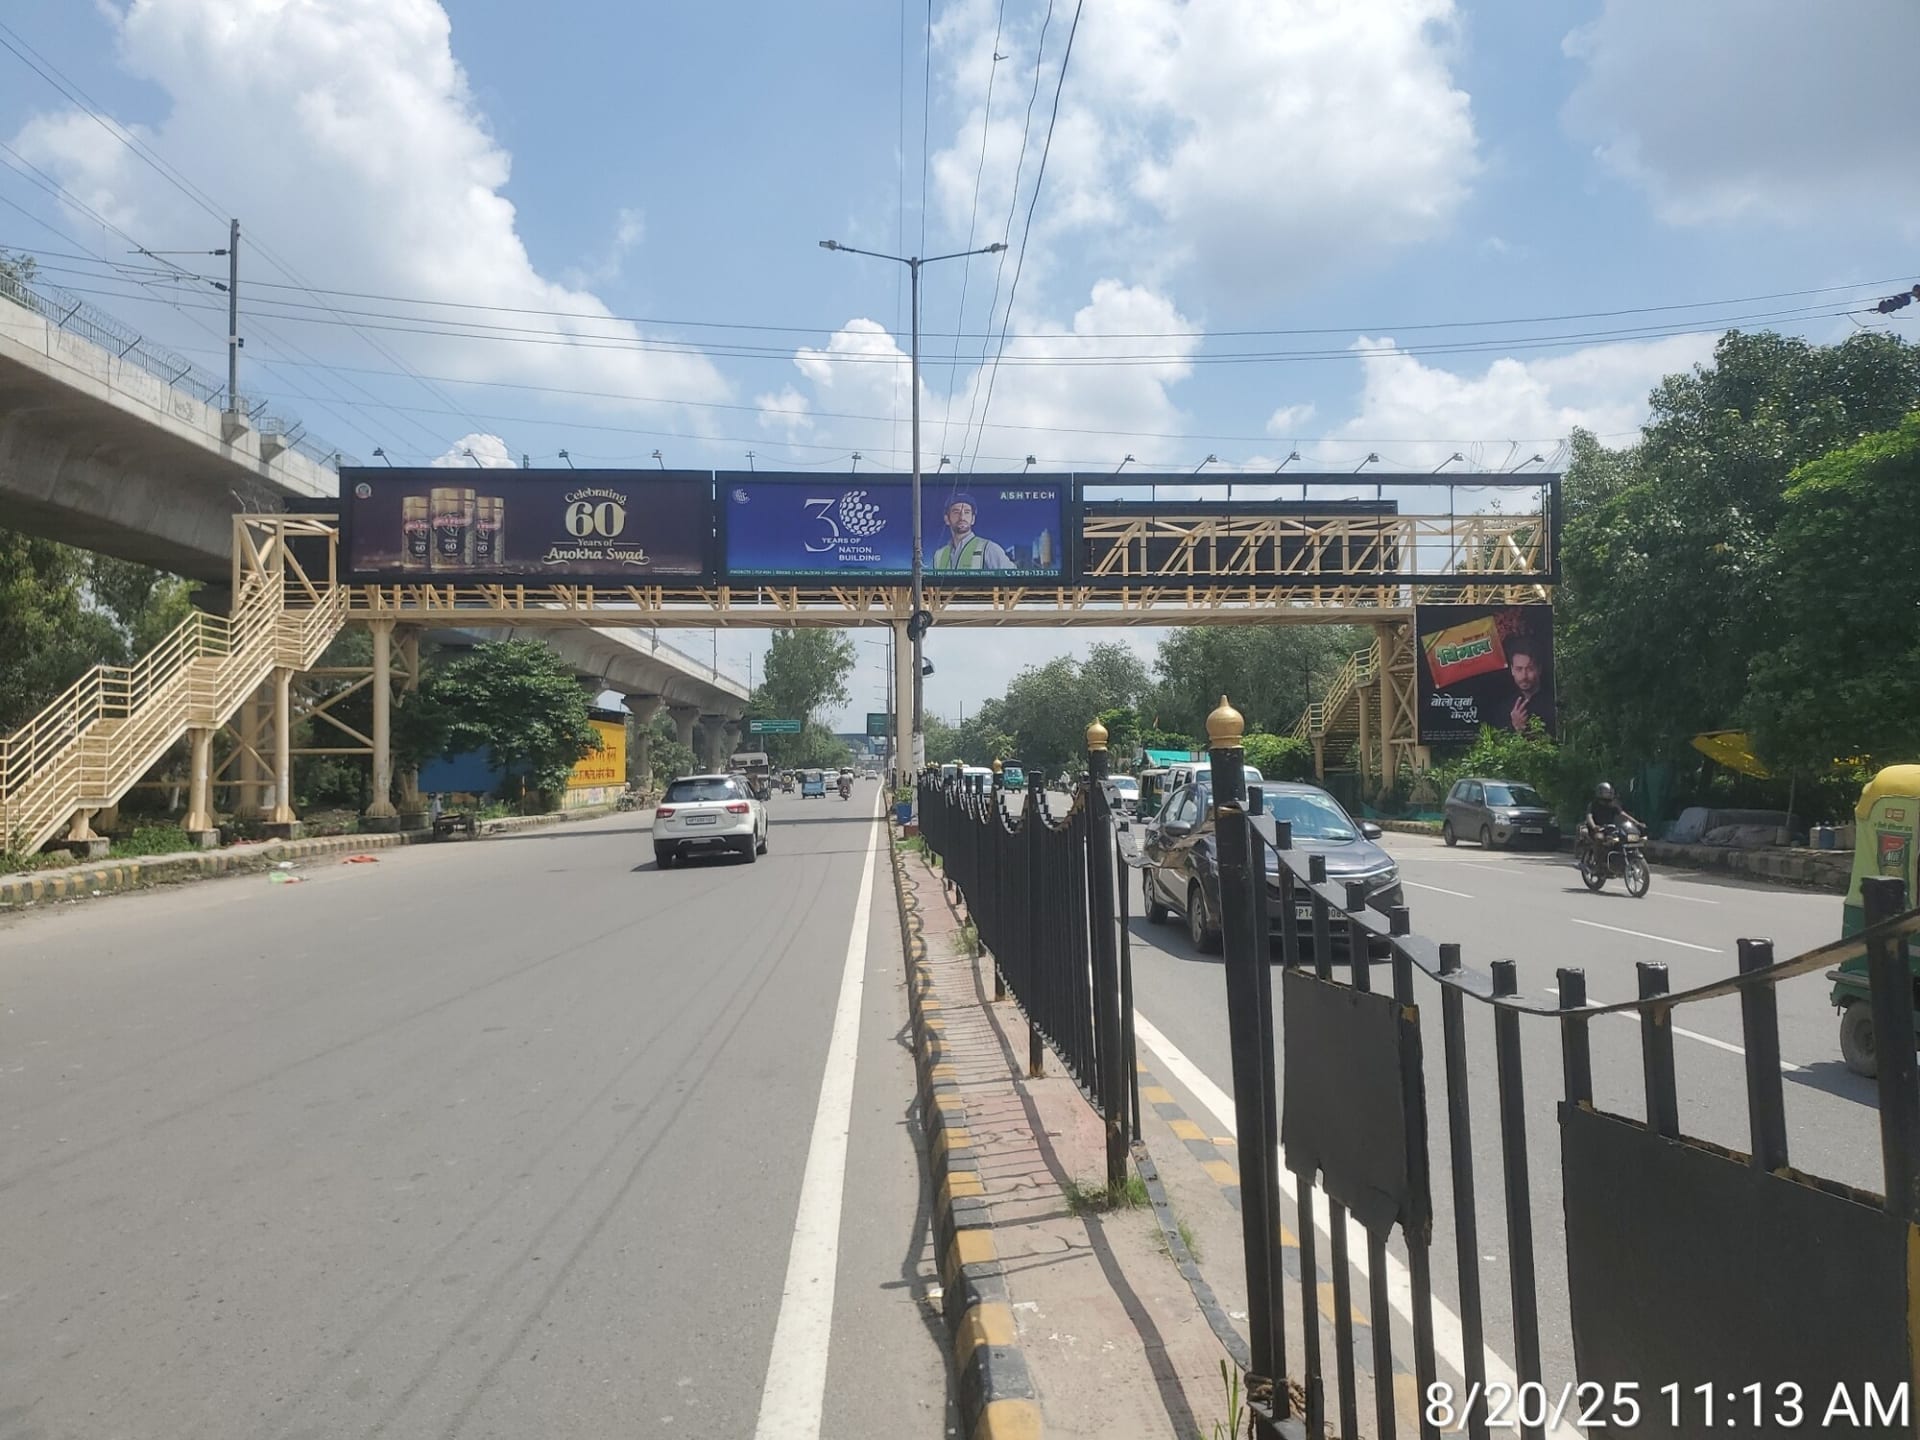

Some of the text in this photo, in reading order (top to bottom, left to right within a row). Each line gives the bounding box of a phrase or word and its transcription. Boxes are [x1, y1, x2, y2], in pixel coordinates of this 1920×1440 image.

[565, 487, 627, 504] Celebrating
[1000, 491, 1055, 500] ASHTECH
[565, 501, 626, 537] 60
[578, 538, 614, 547] Years of
[543, 547, 650, 566] Anokha Swad
[838, 546, 872, 554] NATION
